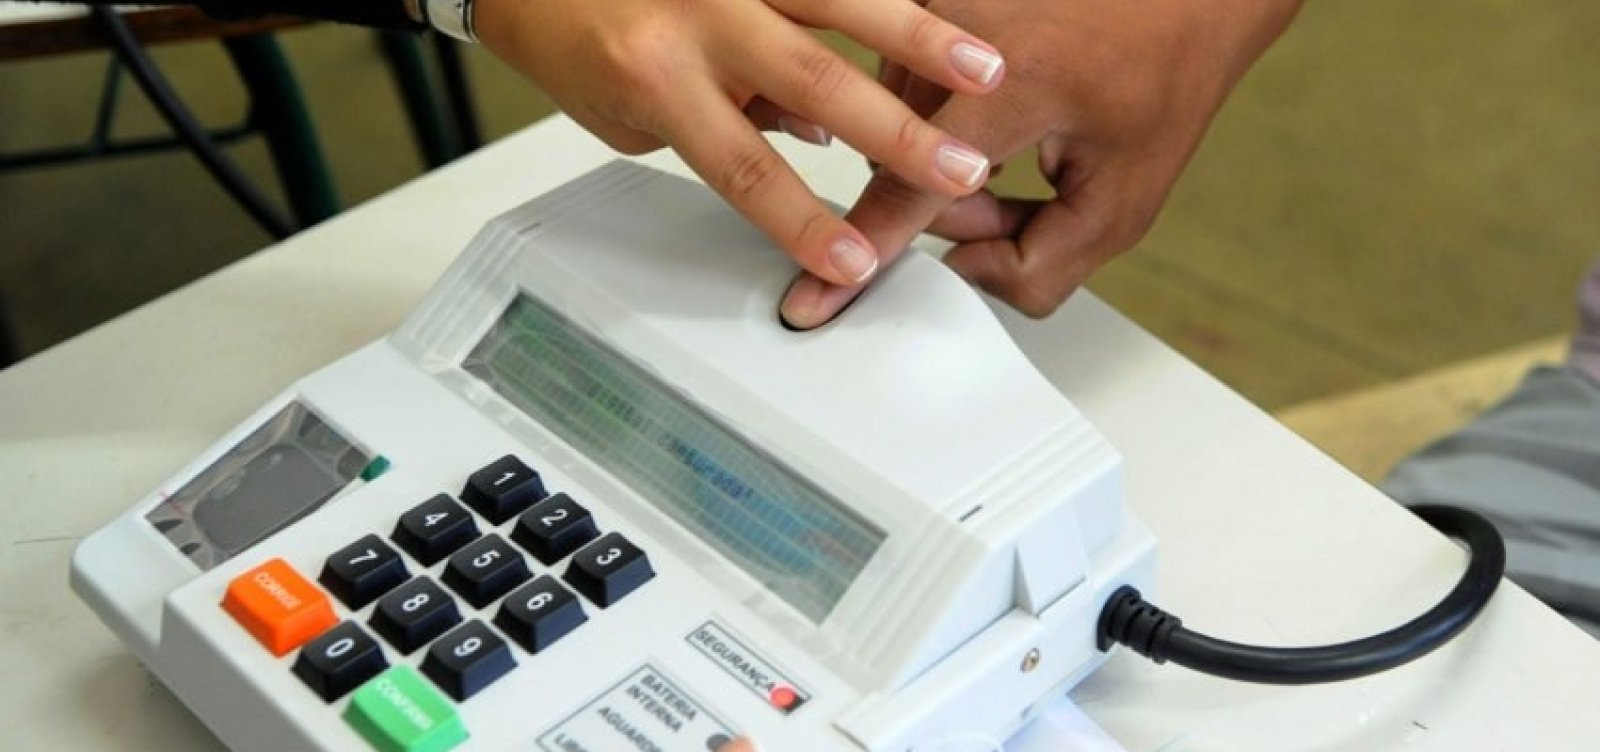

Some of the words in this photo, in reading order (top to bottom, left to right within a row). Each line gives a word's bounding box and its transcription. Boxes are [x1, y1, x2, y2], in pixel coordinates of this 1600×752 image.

[493, 472, 515, 485] 1
[424, 511, 449, 526] 4
[542, 509, 568, 526] 2
[348, 548, 378, 565] 7
[473, 549, 501, 568] 5
[597, 547, 622, 565] 3
[403, 593, 430, 612] 8
[526, 592, 554, 611] 6
[326, 637, 355, 658] 0
[454, 637, 483, 657] 9
[640, 674, 697, 720] BATERIA
[625, 685, 683, 732] INTERNA
[597, 706, 663, 752] AGUARD
